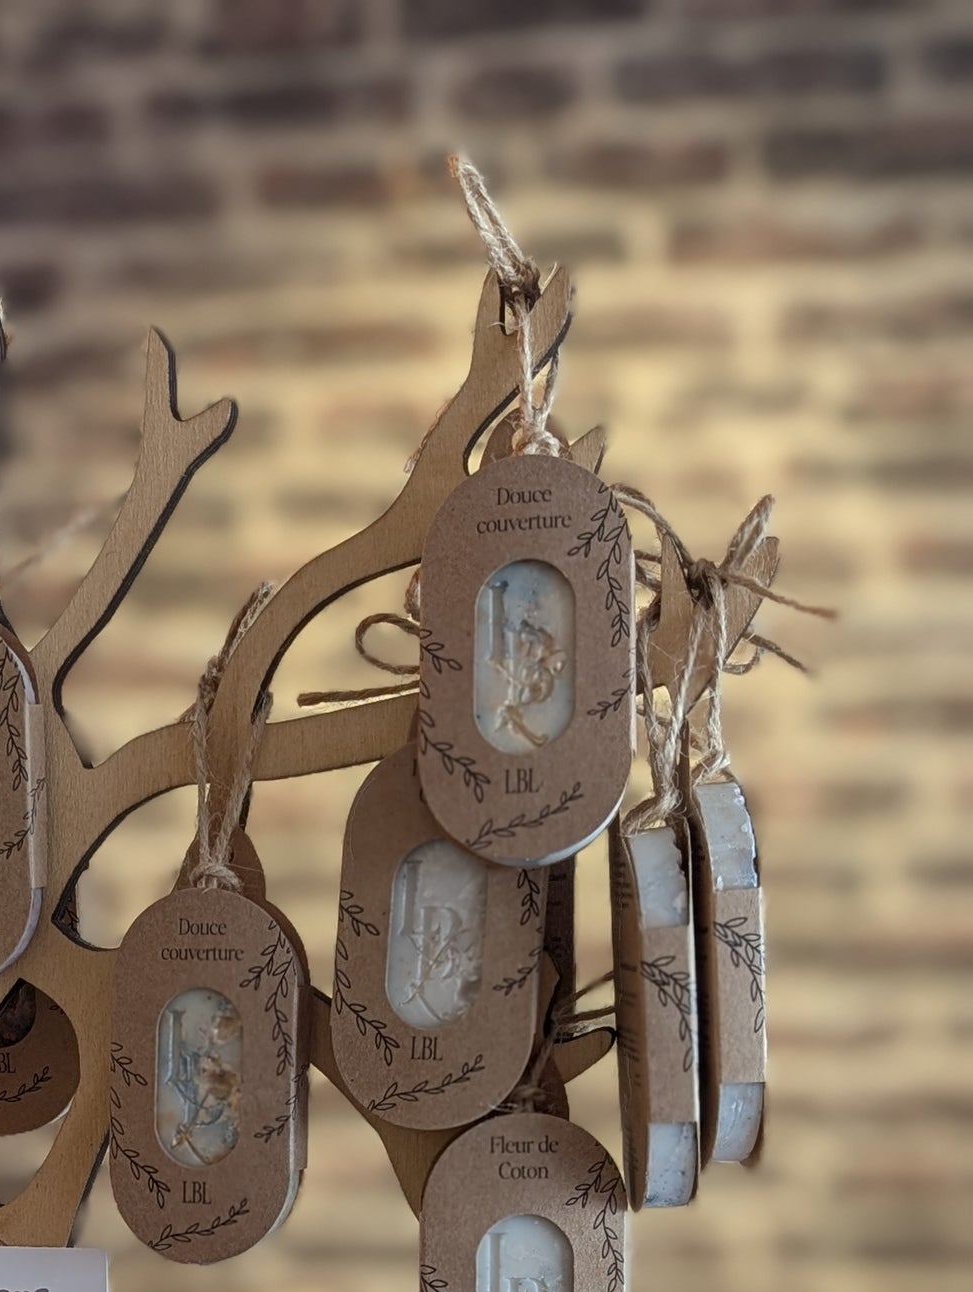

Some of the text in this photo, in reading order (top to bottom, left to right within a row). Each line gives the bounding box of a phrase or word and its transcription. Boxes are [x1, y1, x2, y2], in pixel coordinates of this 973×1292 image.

[497, 487, 552, 506] Douce
[476, 513, 572, 535] couverture
[505, 768, 540, 795] LBL
[178, 917, 227, 937] Douce
[161, 943, 245, 962] couverture
[410, 1036, 444, 1062] LBL
[489, 1136, 559, 1155] Fleur de
[498, 1161, 549, 1181] Coton
